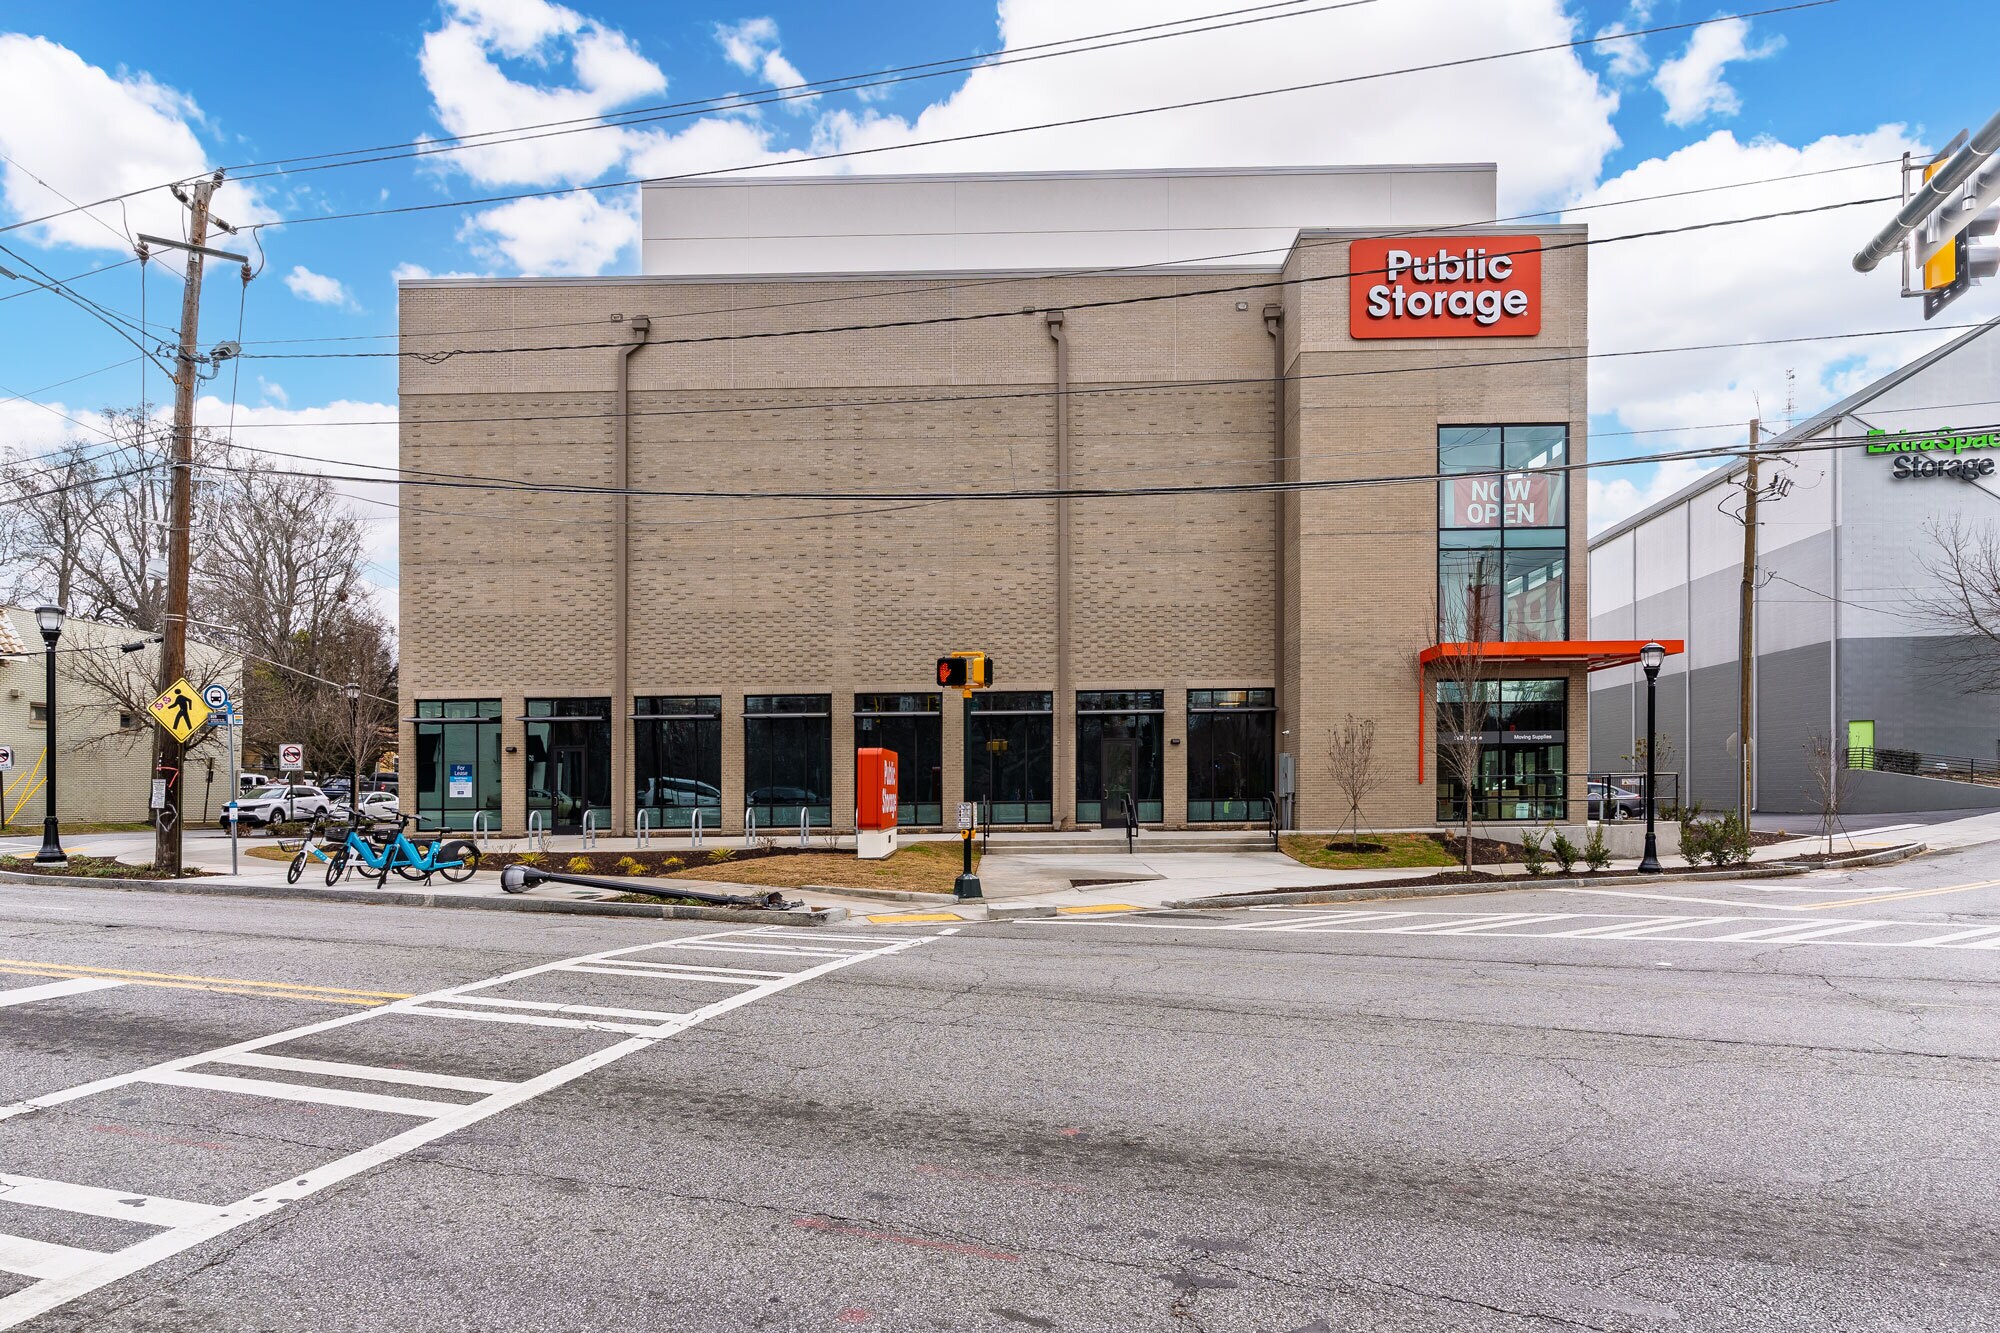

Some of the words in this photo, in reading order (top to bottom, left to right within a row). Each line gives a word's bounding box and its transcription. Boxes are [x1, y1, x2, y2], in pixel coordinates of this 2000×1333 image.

[1387, 248, 1513, 282] Public
[1367, 284, 1529, 325] Storage
[1893, 455, 1995, 481] Storage
[1471, 480, 1531, 502] NOW
[1467, 503, 1536, 524] OPEN
[884, 760, 896, 785] Public
[882, 788, 896, 819] Storage
